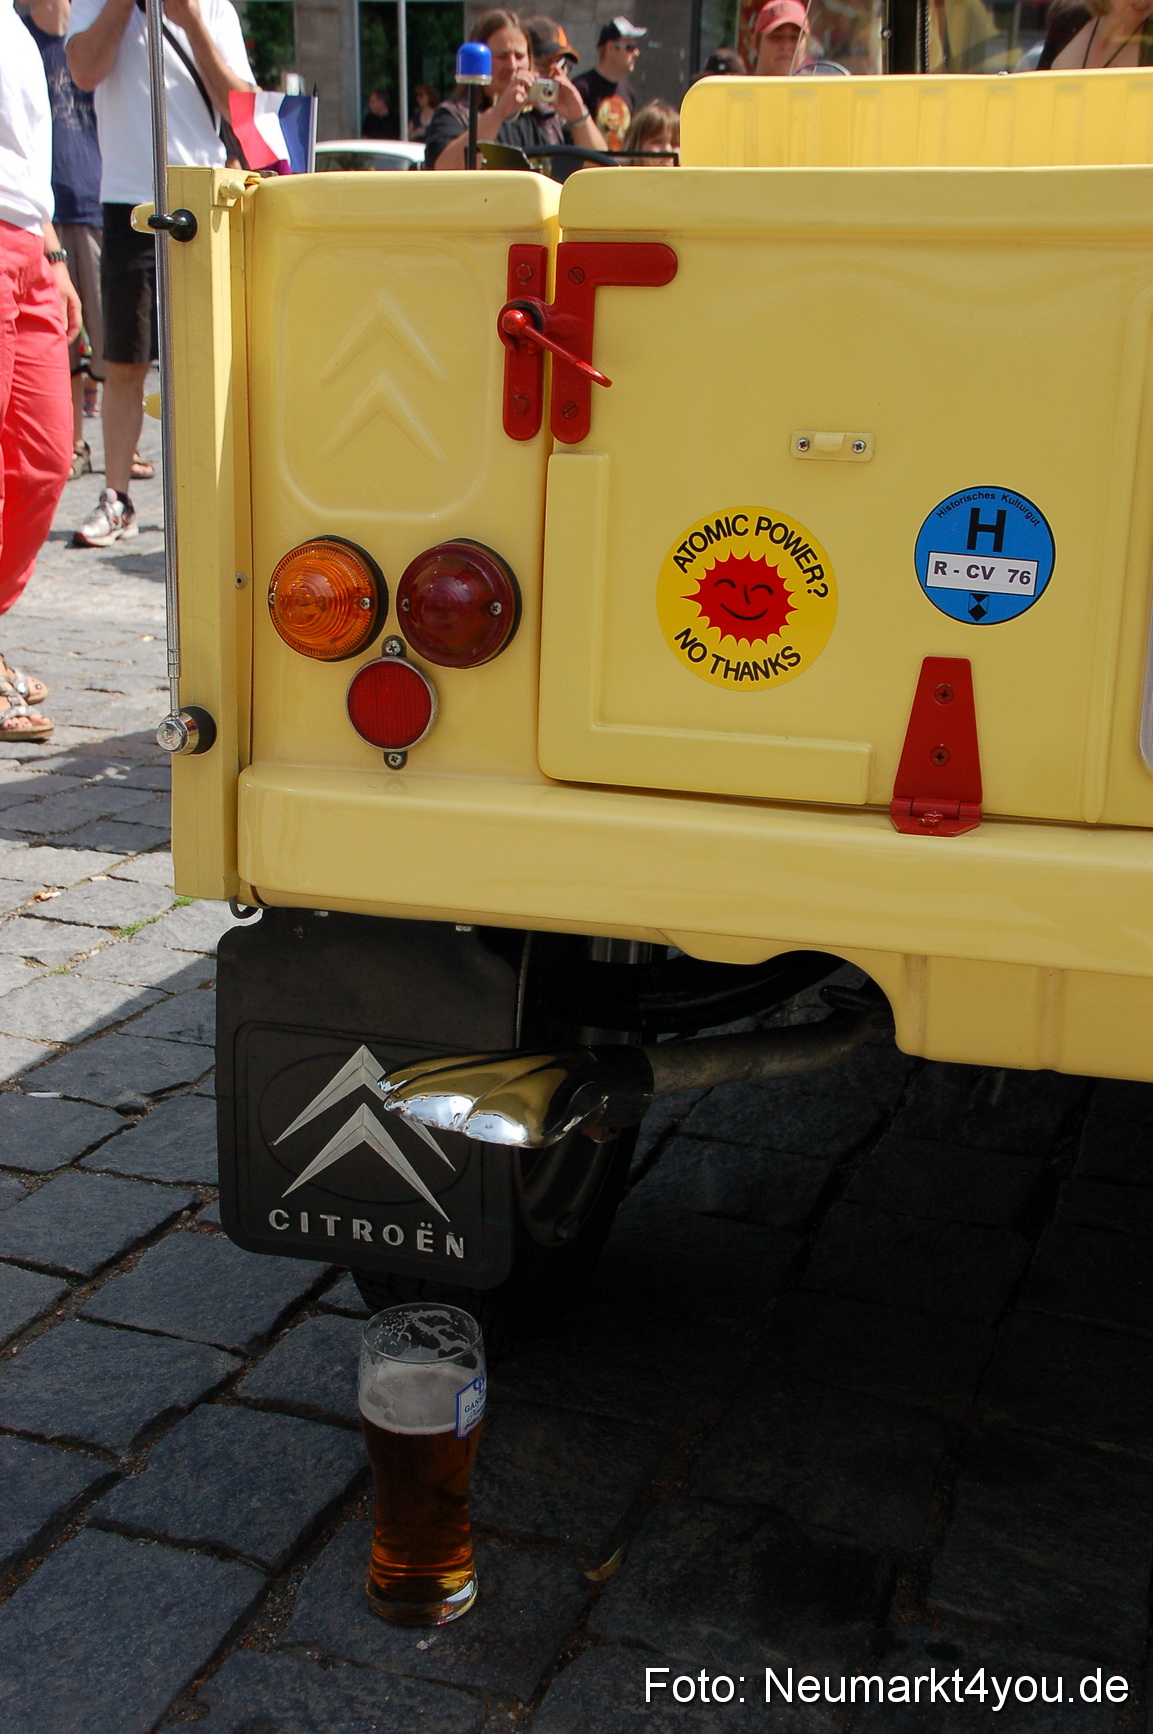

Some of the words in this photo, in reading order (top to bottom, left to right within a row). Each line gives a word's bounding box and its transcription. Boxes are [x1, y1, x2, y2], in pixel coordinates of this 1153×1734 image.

[936, 491, 996, 519] Historisches
[1001, 493, 1041, 527] Kulturgut
[966, 507, 1007, 553] H
[673, 514, 749, 574] ATOMIC
[754, 516, 829, 598] POWER?
[1007, 568, 1032, 585] 76
[674, 627, 708, 663] NO
[710, 645, 802, 682] THANKS
[268, 1209, 464, 1258] CITROËN
